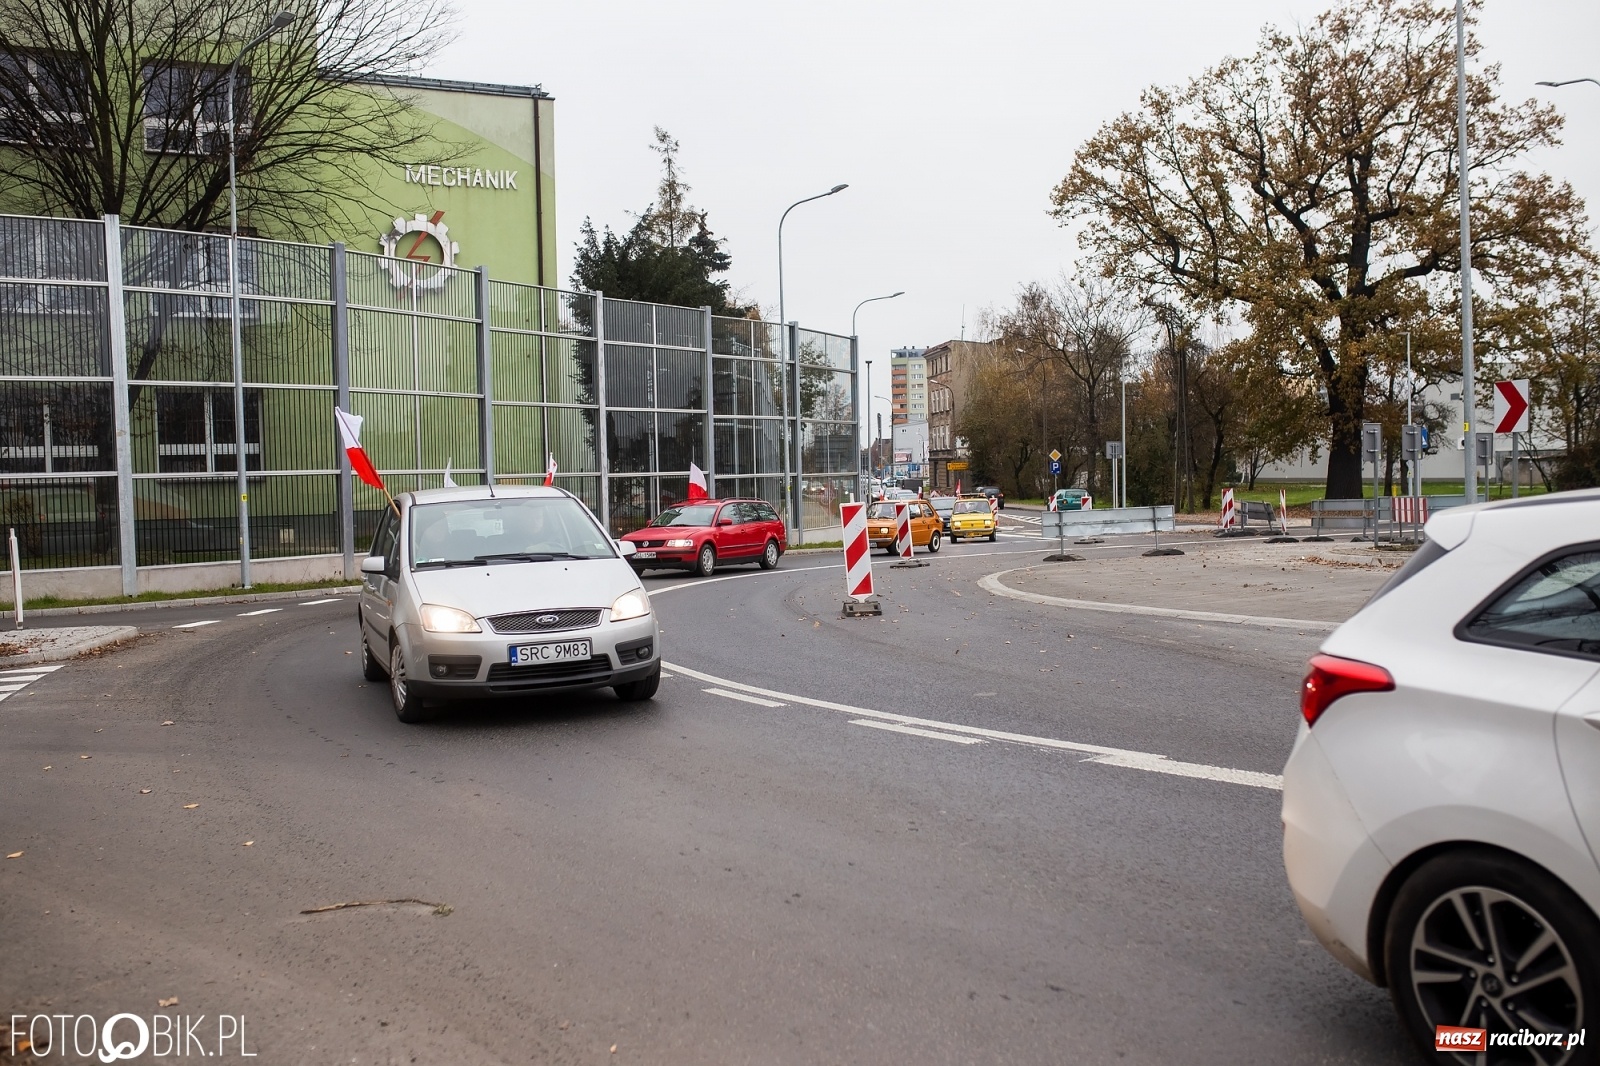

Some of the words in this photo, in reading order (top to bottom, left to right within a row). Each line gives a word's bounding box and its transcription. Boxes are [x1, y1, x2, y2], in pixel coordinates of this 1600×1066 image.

[405, 164, 518, 190] MECHANIK
[519, 646, 550, 662] SRC
[555, 642, 588, 659] 9M83
